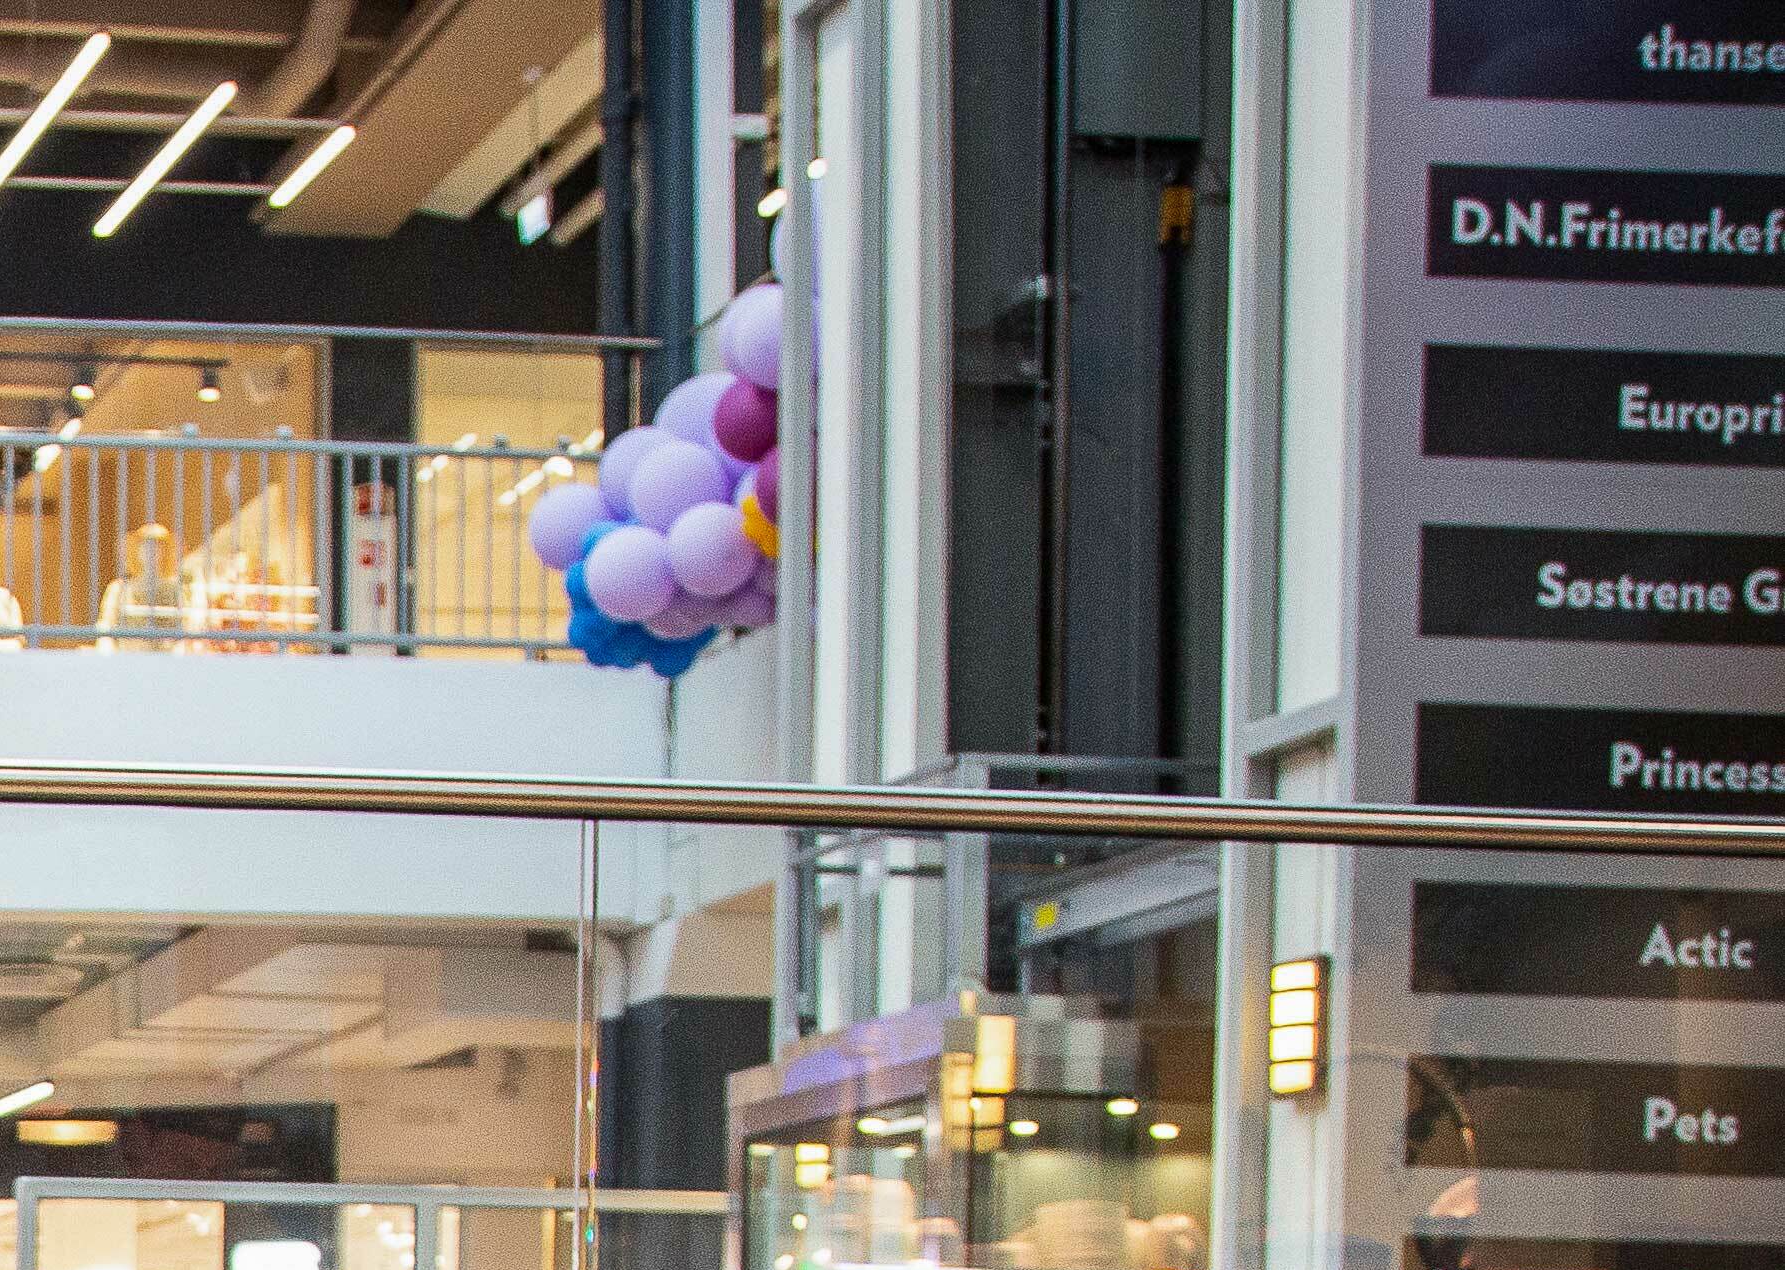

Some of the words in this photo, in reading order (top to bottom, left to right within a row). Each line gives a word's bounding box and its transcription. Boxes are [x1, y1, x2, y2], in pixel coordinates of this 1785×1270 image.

[1742, 566, 1785, 616] G
[1637, 920, 1757, 971] Actic
[1642, 1094, 1743, 1144] Pets
